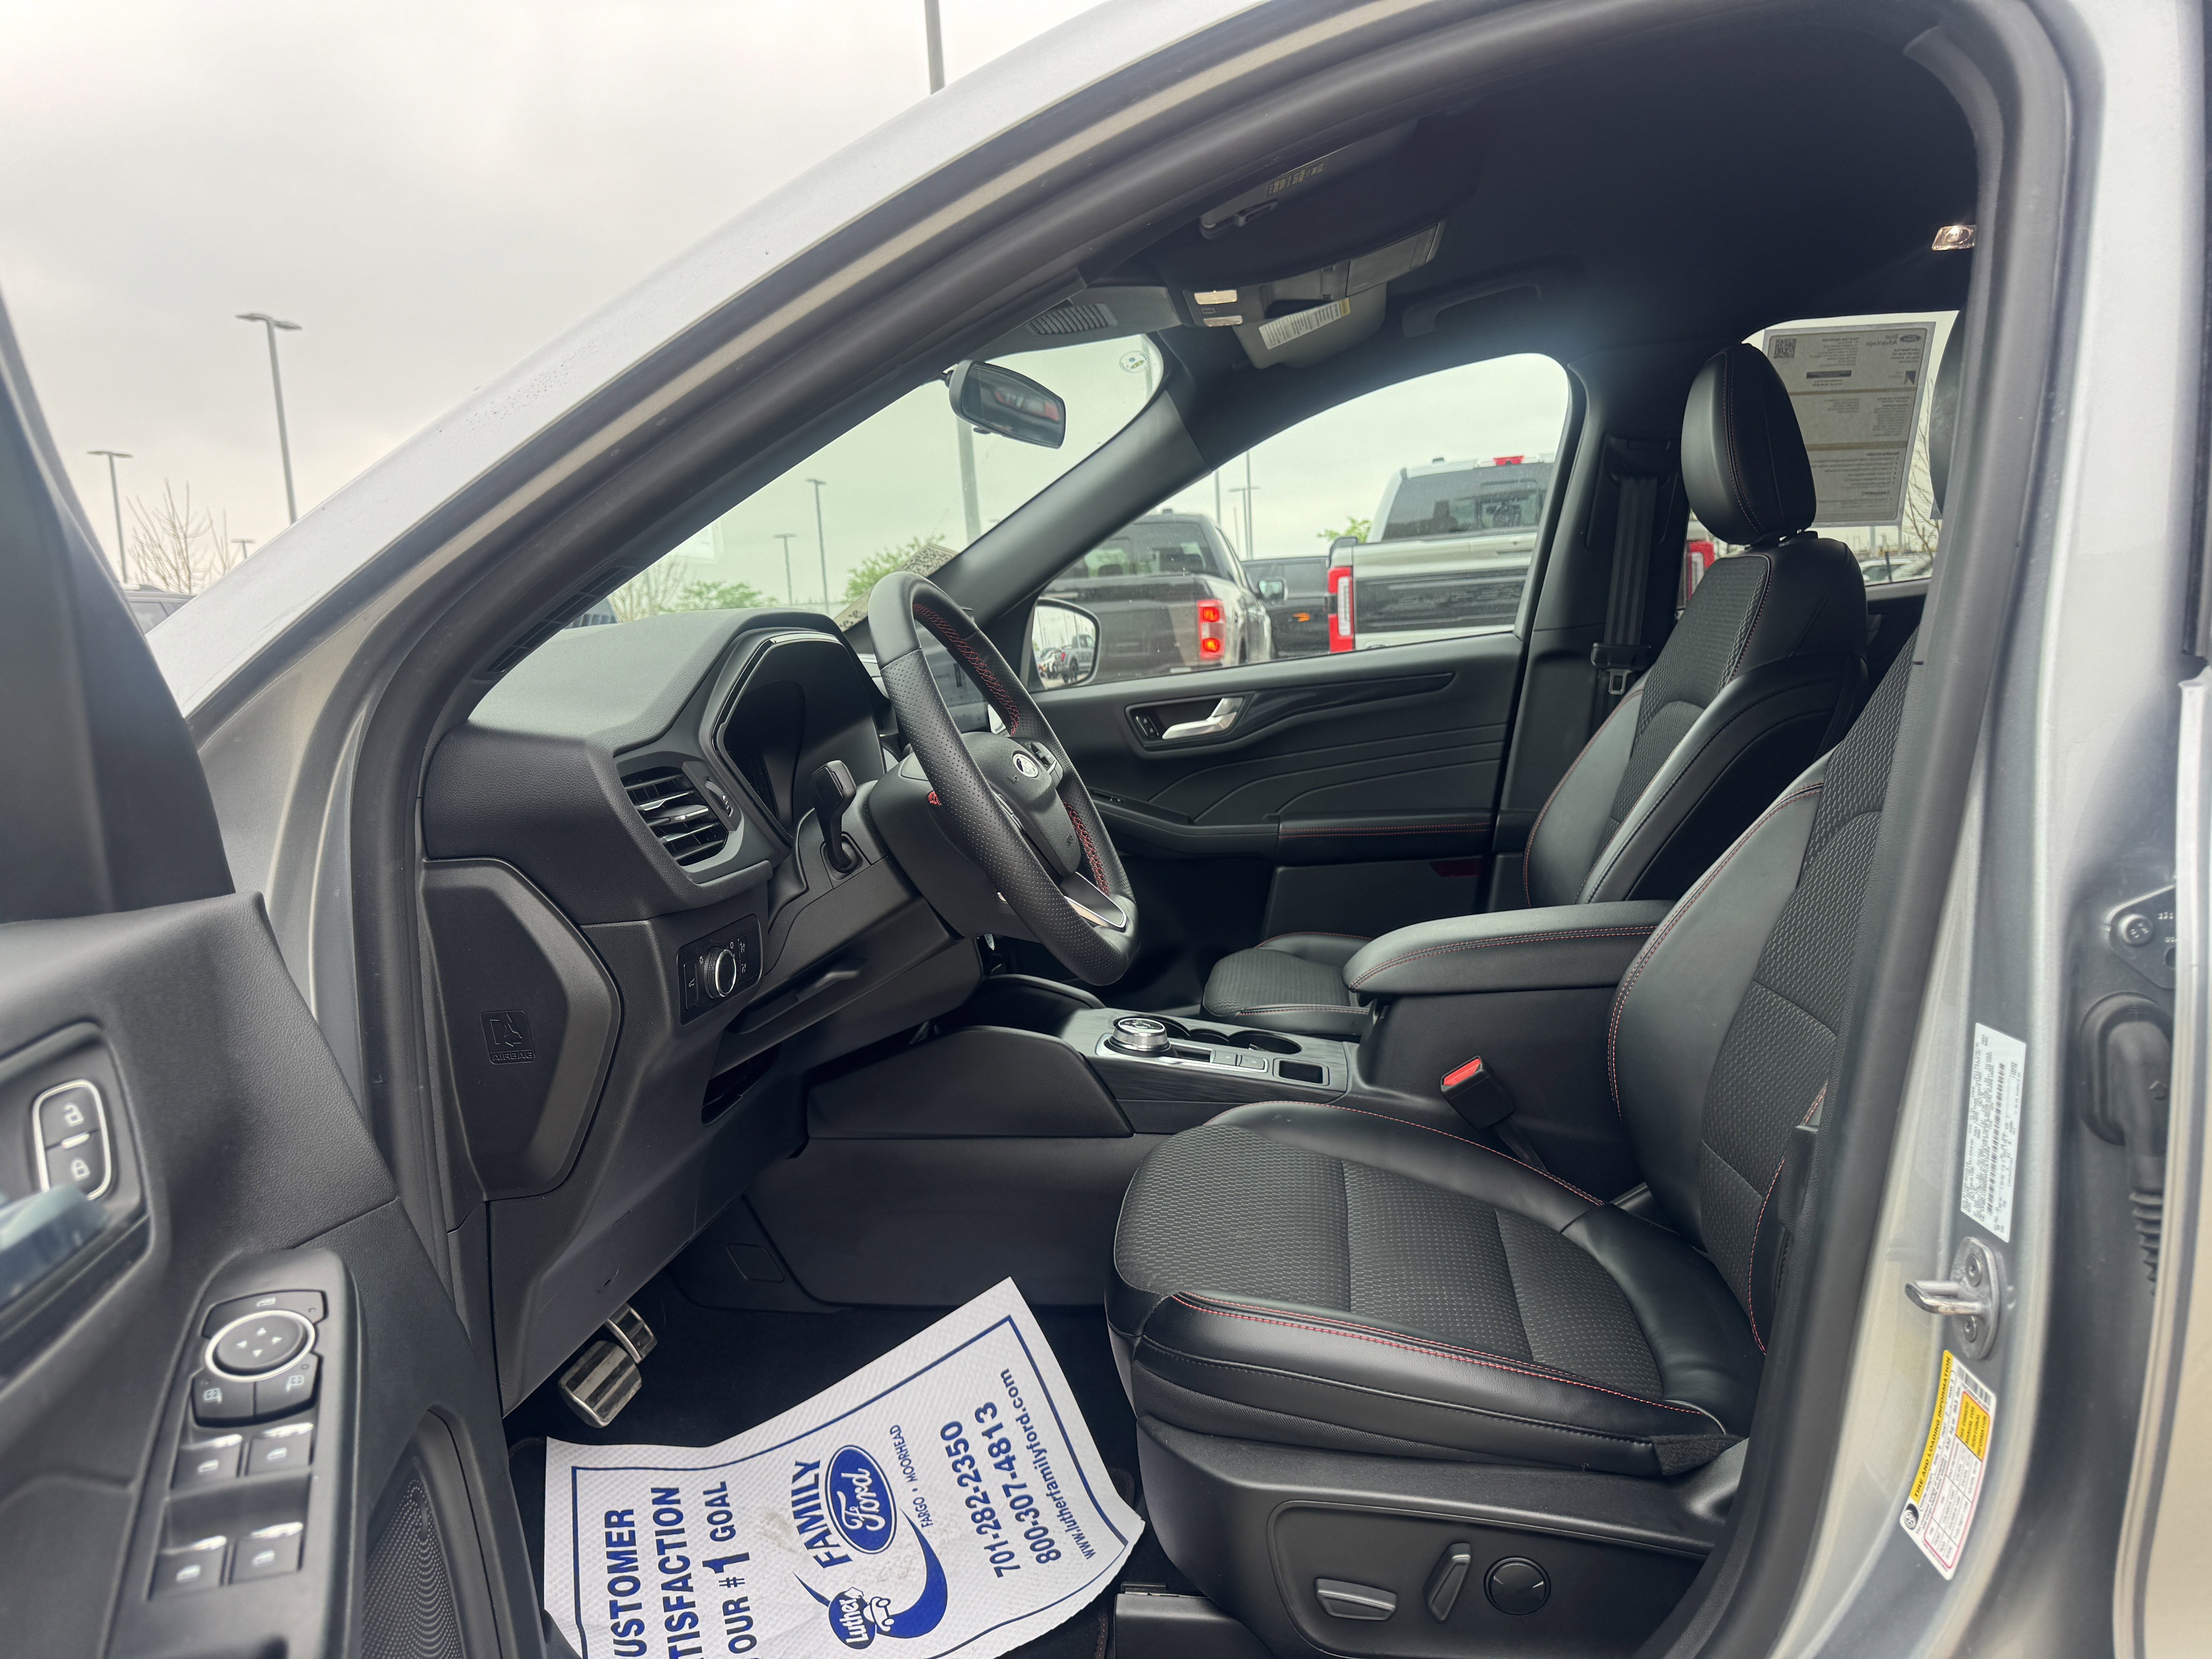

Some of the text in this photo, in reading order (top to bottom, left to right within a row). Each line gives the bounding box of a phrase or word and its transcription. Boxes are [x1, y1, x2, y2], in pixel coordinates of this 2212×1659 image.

[493, 1052, 533, 1061] AIRBAG
[889, 1424, 934, 1528] FARGO MOORHEAD
[1000, 1367, 1096, 1560] www.lutherfamilyford.com
[1914, 1478, 1923, 1498] TIRE
[1921, 1459, 1929, 1478] AND
[1927, 1419, 1940, 1457] LOADING
[1937, 1356, 1950, 1418] INFORMATION
[702, 1480, 736, 1542] GOAL
[791, 1459, 854, 1569] FAMILY
[836, 1468, 886, 1532] Ford
[940, 1420, 1021, 1578] 701-282-2350
[974, 1401, 1061, 1564] 800-307-4813
[604, 1508, 647, 1659] USTOMER
[651, 1486, 704, 1659] TISFACTION
[722, 1595, 757, 1654] OUR
[839, 1598, 870, 1643] Luther
